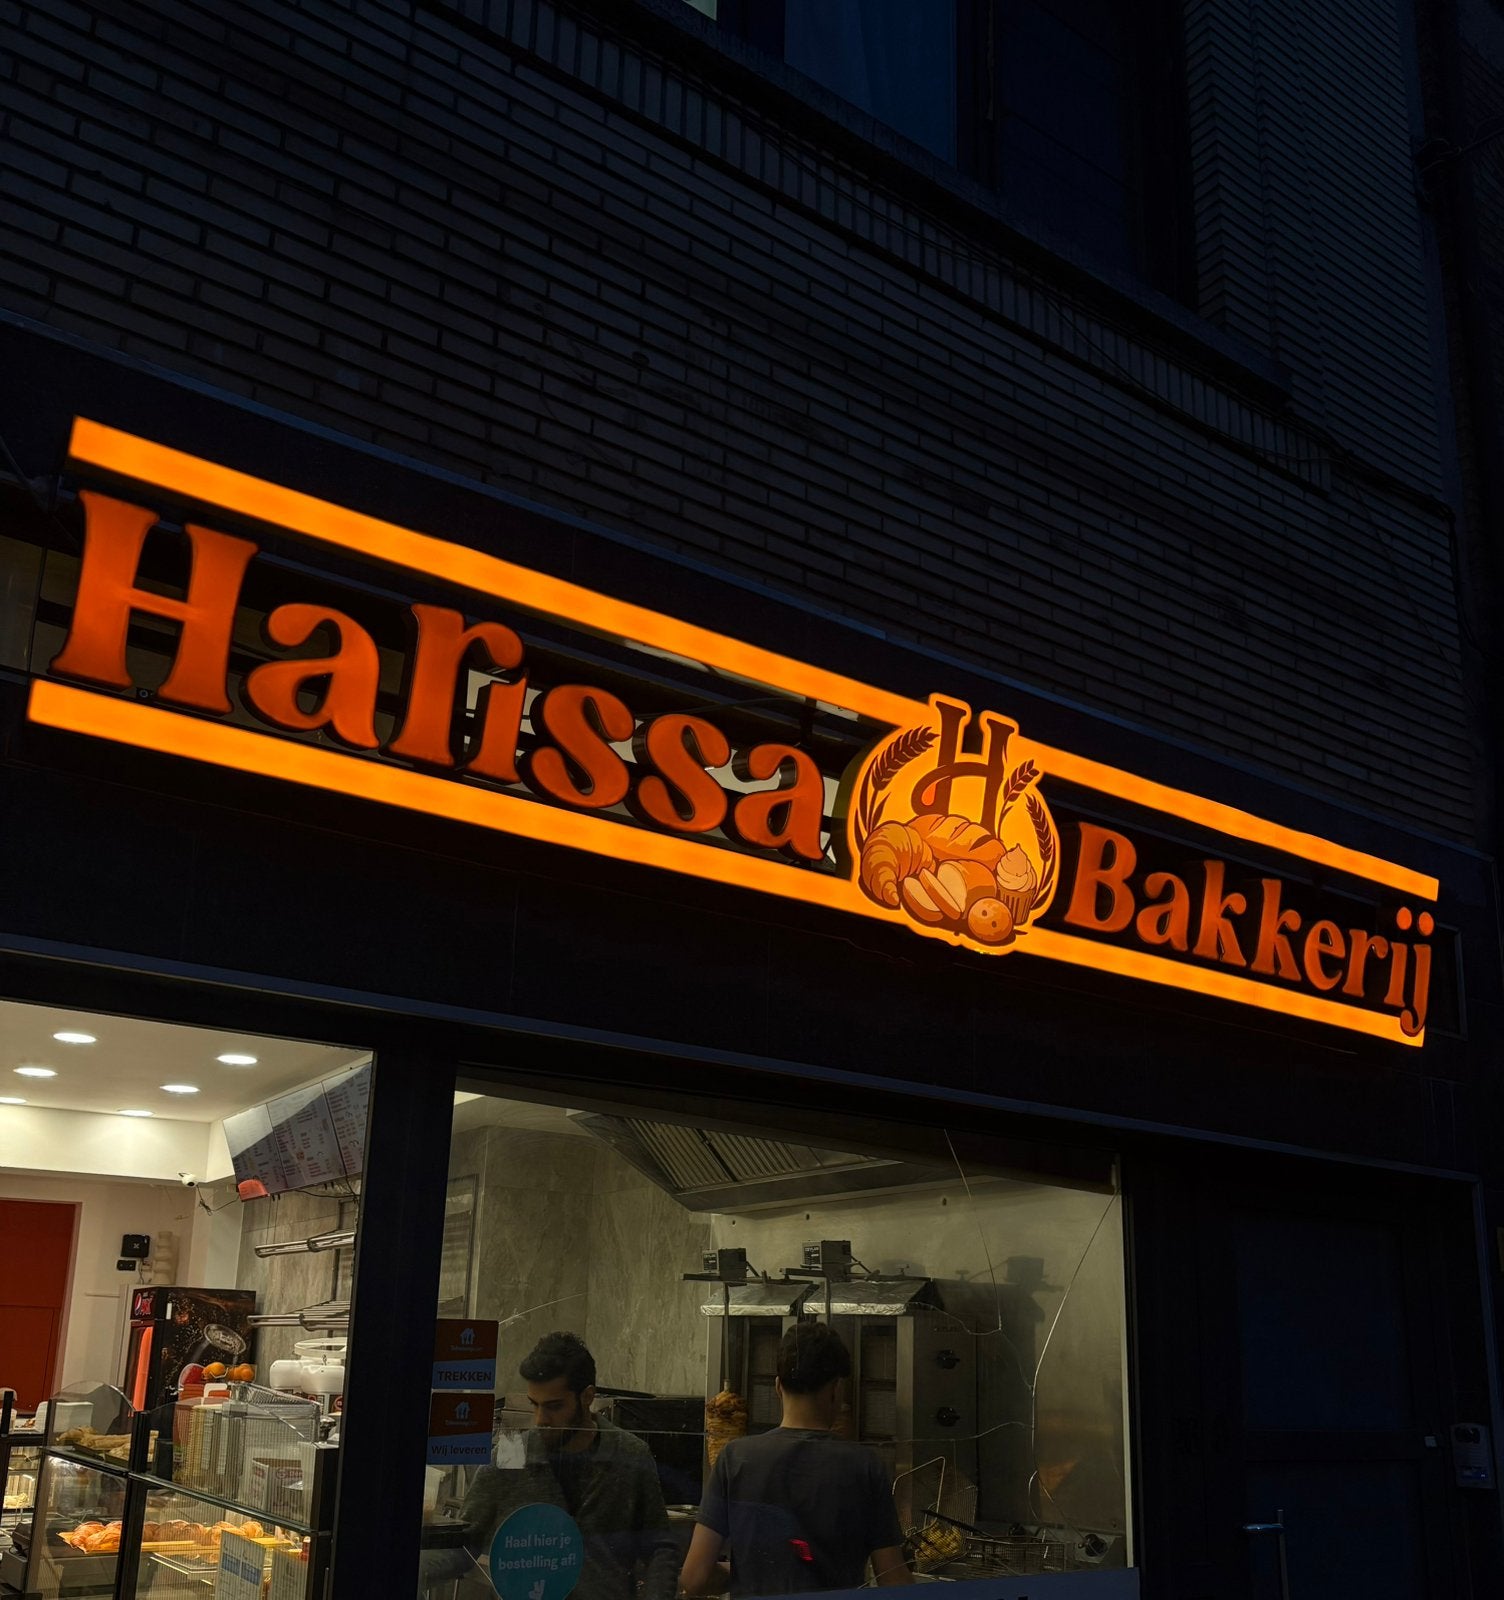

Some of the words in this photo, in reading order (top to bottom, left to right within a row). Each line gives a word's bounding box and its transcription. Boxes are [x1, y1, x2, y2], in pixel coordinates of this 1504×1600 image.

[48, 489, 825, 862] Harissa
[1063, 822, 1435, 1037] Bakkerij
[437, 1370, 493, 1383] TREKKEN
[431, 1445, 449, 1456] Wij
[450, 1445, 488, 1455] leveren
[504, 1534, 531, 1549] Haal
[533, 1533, 558, 1548] hier
[559, 1532, 572, 1549] je
[498, 1554, 559, 1571] bestelling
[560, 1552, 577, 1567] af!
